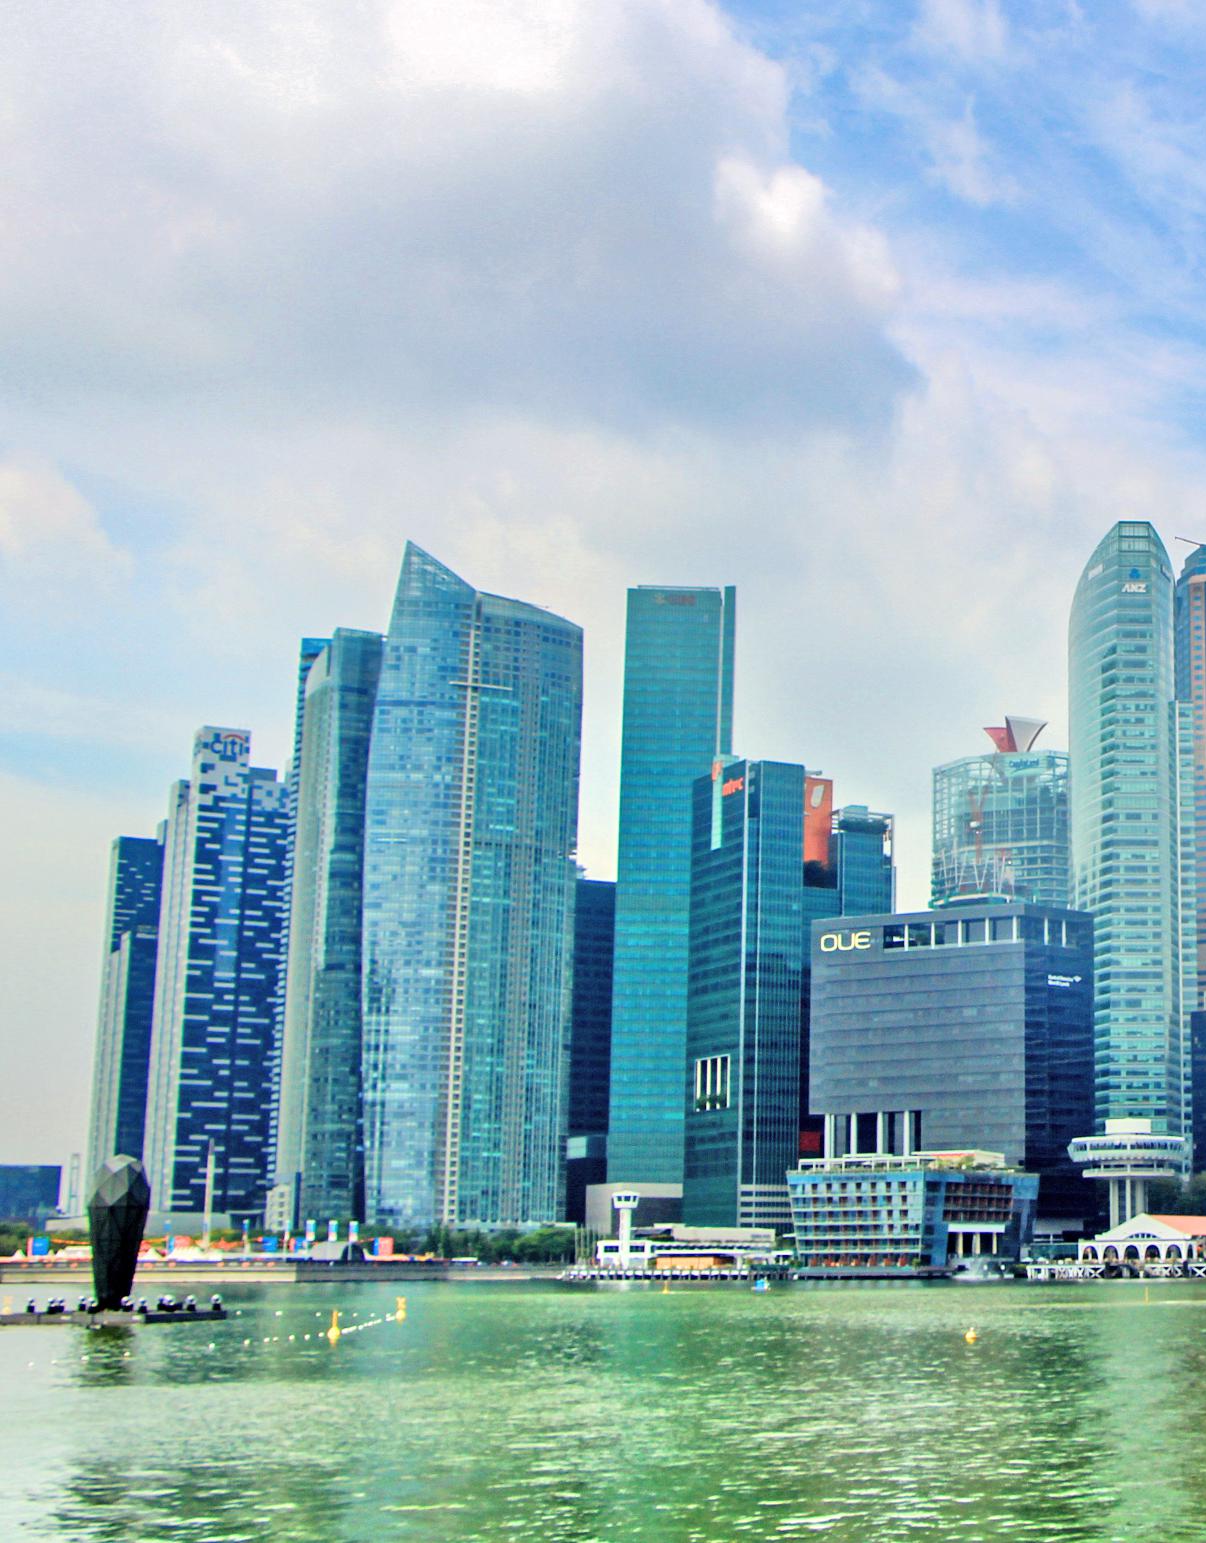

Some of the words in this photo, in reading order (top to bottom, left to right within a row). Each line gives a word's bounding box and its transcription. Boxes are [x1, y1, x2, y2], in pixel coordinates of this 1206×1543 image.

[1121, 583, 1146, 592] ANZ
[210, 737, 243, 755] citi
[820, 931, 871, 952] OUE
